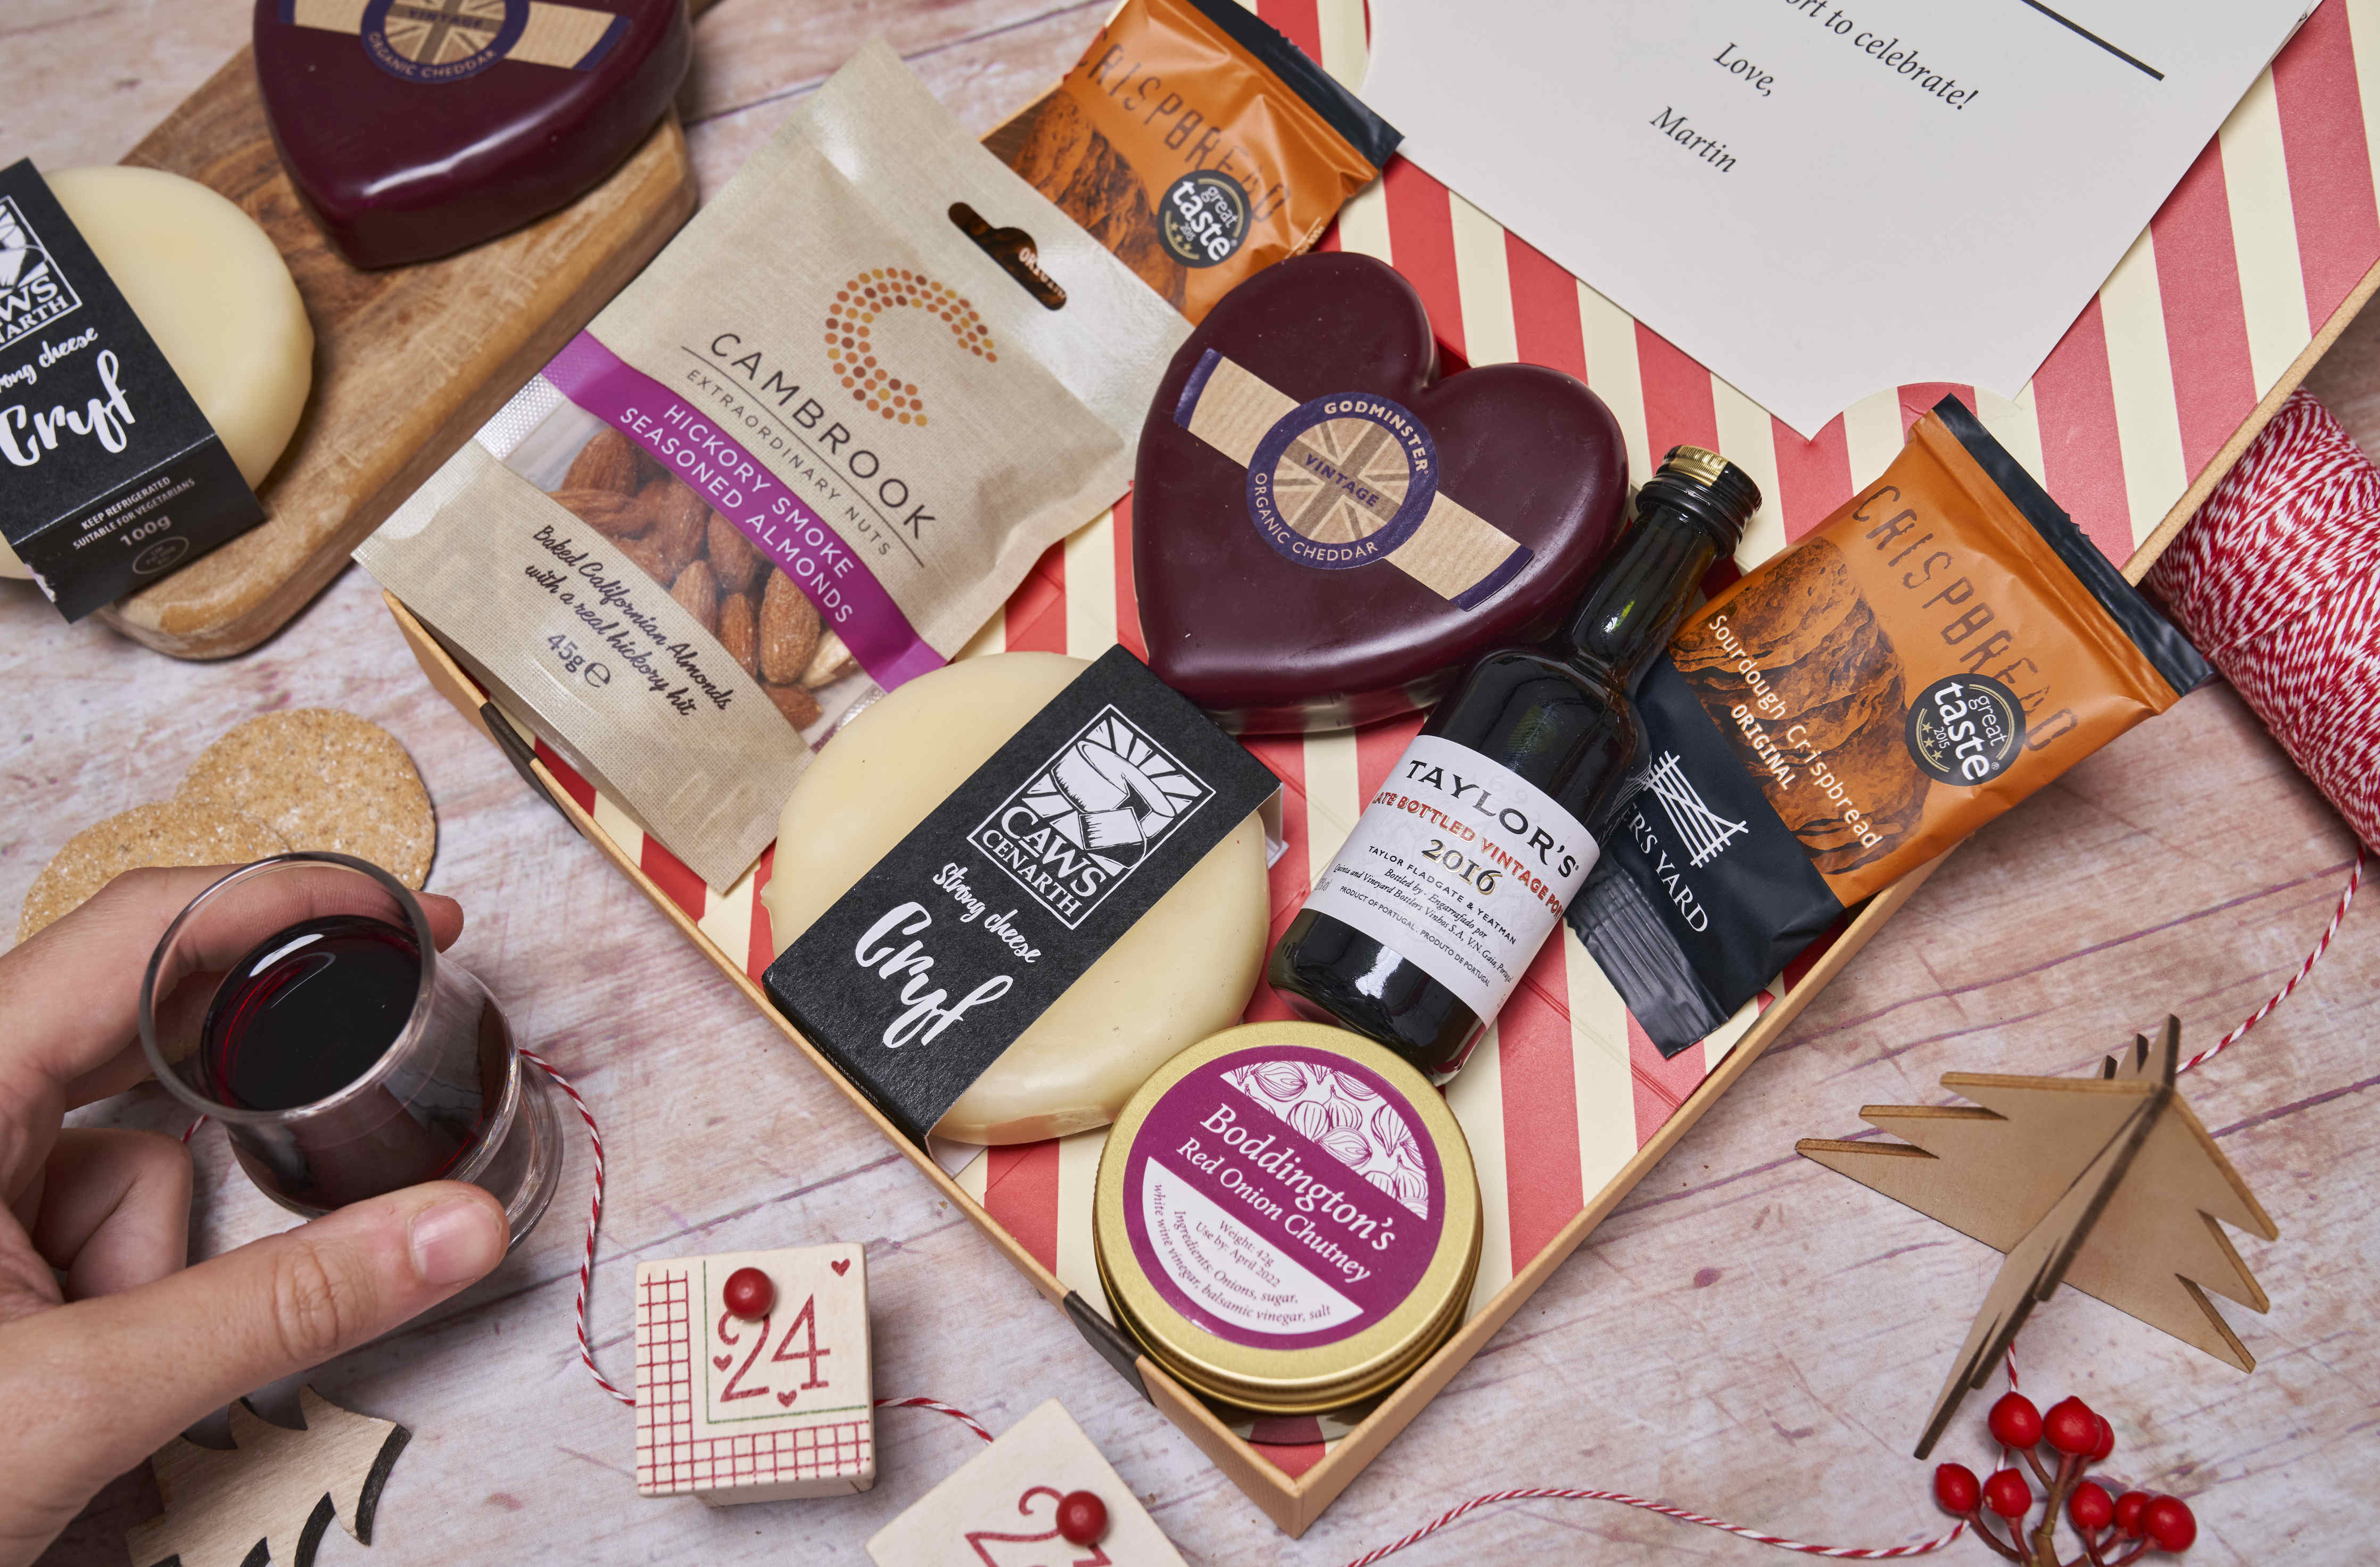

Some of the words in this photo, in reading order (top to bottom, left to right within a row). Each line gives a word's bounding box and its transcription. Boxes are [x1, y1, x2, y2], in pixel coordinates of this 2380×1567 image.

[368, 31, 417, 76] ORGANIC
[420, 49, 496, 78] CHEDDAR
[408, 8, 483, 28] VINTAGE
[1713, 42, 1775, 97] Love,
[1824, 10, 1853, 35] to
[1854, 32, 1979, 110] celebrate!
[1078, 30, 1291, 223] RISPBREAD
[1649, 105, 1737, 173] Martin
[1172, 181, 1230, 261] taste
[1200, 186, 1239, 229] great
[38, 327, 98, 368] cheese
[0, 349, 136, 467] Cryf
[711, 333, 937, 540] CAMBROOK
[81, 512, 105, 530] KEEP
[105, 476, 171, 518] REFRIGERATED
[663, 404, 771, 493] HICKORY
[772, 498, 854, 578] SMOKE
[687, 369, 841, 502] EXTRAORDINARY
[844, 505, 891, 556] NUTS
[1305, 453, 1380, 508] VINTAGE
[72, 521, 118, 550] SUITABLE
[116, 511, 137, 527] FOR
[134, 477, 196, 516] VEGETARIANS
[120, 515, 172, 546] 100g
[619, 408, 742, 508] SEASONED
[746, 513, 853, 623] ALMONDS
[1254, 472, 1291, 544] ORGANIC
[1292, 541, 1379, 562] CHEDDAR
[525, 564, 567, 594] with
[559, 591, 575, 605] a
[573, 602, 620, 635] real
[605, 631, 670, 692] hickory
[666, 687, 697, 716] hit
[533, 525, 589, 568] Baked
[578, 562, 668, 645] Californian
[665, 642, 734, 710] Almonds
[547, 633, 585, 674] 45g
[1709, 615, 1788, 719] Sourdough
[1787, 724, 1883, 849] Crispbread
[1731, 704, 1796, 791] ORIGINAL
[1933, 726, 1951, 749] 2015
[1934, 682, 1990, 781] taste
[1968, 695, 2007, 747] great
[1000, 805, 1108, 898] CAWS
[1397, 795, 1476, 843] BOTTLED
[1481, 836, 1549, 901] VINTAGE
[1406, 759, 1577, 878] TAYLOR'S
[981, 828, 1084, 918] CENARTH
[1368, 845, 1404, 867] TAYLOR
[1407, 864, 1465, 903] FLADGATE
[1466, 901, 1474, 910] &
[1477, 908, 1517, 946] YEATMAN
[1384, 868, 1415, 888] Bottled
[1427, 893, 1475, 930] Engarrafado
[1472, 927, 1488, 940] por
[1421, 839, 1503, 896] 2016
[1655, 849, 1708, 932] YARD
[984, 909, 1042, 964] cheese
[1333, 863, 1350, 874] Quinta
[1349, 868, 1365, 878] and
[1362, 873, 1396, 894] Vineyard
[1393, 888, 1423, 911] Bottlers
[1467, 936, 1482, 954] V.N.
[1482, 949, 1498, 968] Gaia,
[1496, 963, 1515, 984] Portugal
[1339, 885, 1368, 903] PRODUCT
[1368, 899, 1379, 908] OF
[1377, 904, 1415, 931] PORTUGAL
[1419, 929, 1455, 956] PRODUTO
[1453, 953, 1465, 964] DE
[1463, 960, 1491, 988] PORTUGAL
[855, 901, 1014, 1049] Cryf
[1153, 1183, 1166, 1216] white
[1176, 1137, 1225, 1175] Red
[1219, 1167, 1282, 1221] Onion
[1284, 1213, 1371, 1283] Chutney
[1200, 1103, 1395, 1251] Boddington's
[1156, 1218, 1172, 1247] wine
[1168, 1247, 1201, 1290] vinegar,
[1173, 1210, 1214, 1273] Ingredients:
[1214, 1270, 1257, 1300] Onions,
[1260, 1291, 1299, 1307] sugar,
[1196, 1221, 1214, 1240] Use
[1214, 1235, 1229, 1252] by:
[1230, 1248, 1258, 1271] April
[1255, 1266, 1281, 1288] 2022
[1219, 1220, 1255, 1252] Weight:
[1257, 1249, 1275, 1268] 42g
[1201, 1283, 1254, 1317] balsamic
[1257, 1308, 1305, 1326] vinegar,
[1309, 1304, 1331, 1320] salt
[717, 1293, 831, 1404] 24
